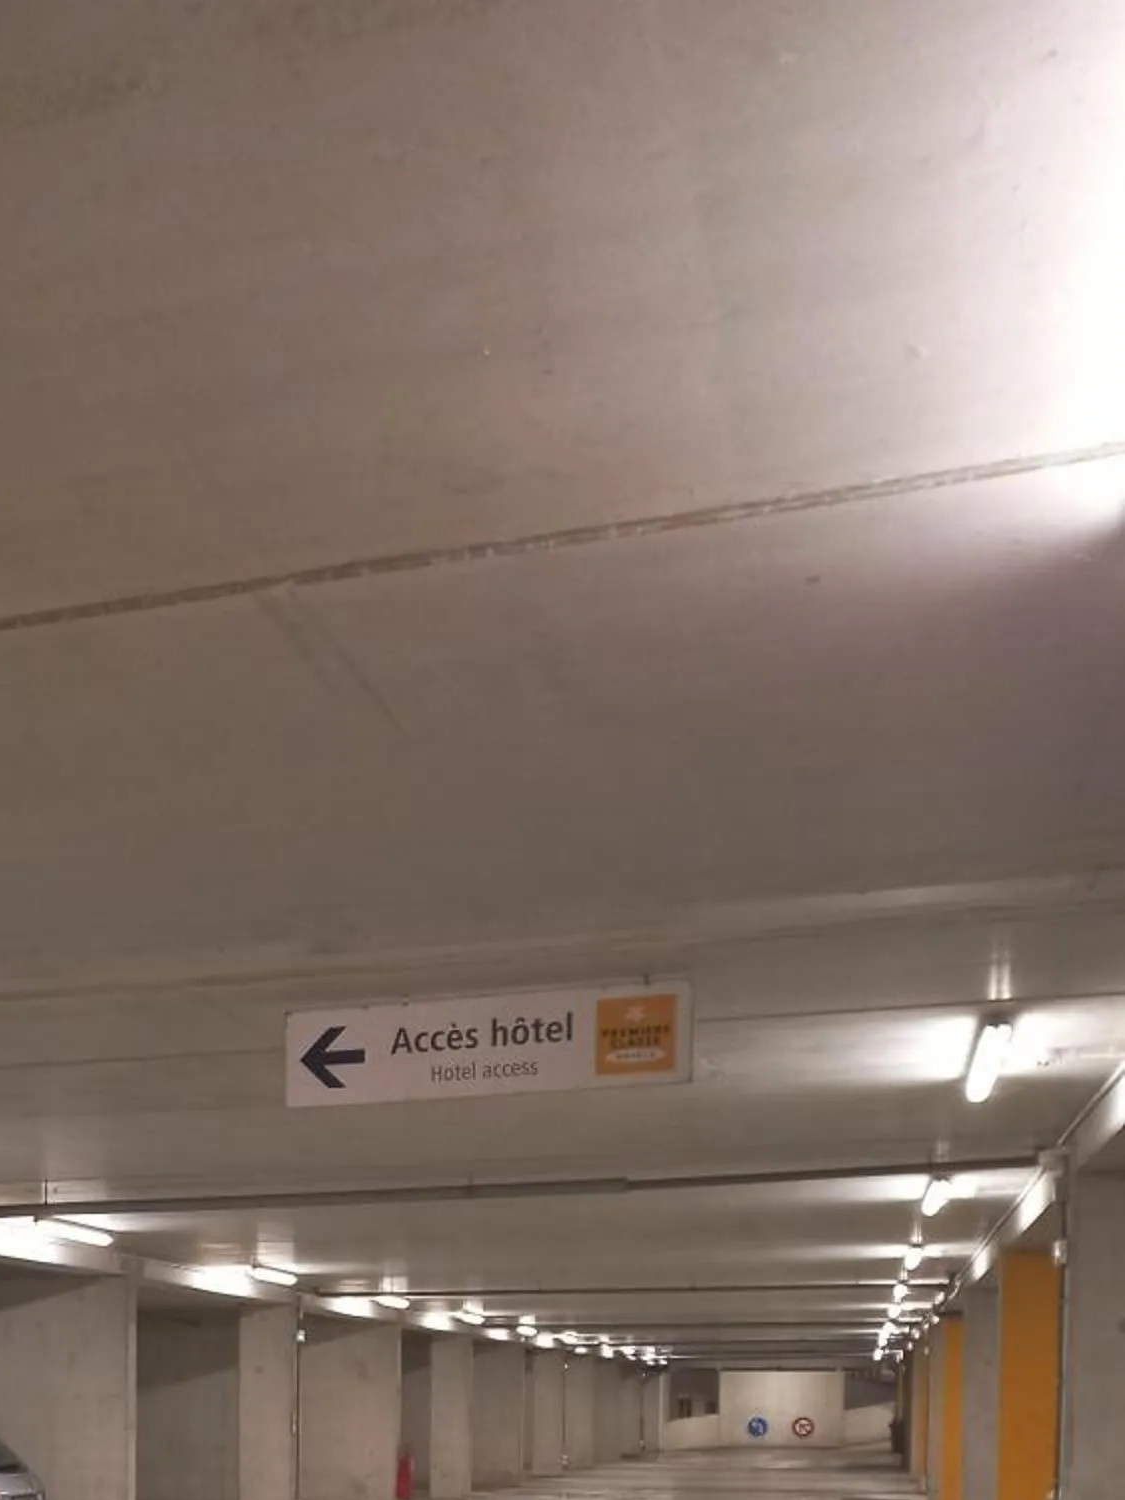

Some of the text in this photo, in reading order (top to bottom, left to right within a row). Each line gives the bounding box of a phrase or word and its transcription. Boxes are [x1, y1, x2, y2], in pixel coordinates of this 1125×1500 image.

[391, 1011, 573, 1056] Accès hôtel
[431, 1059, 539, 1084] Hotel access
